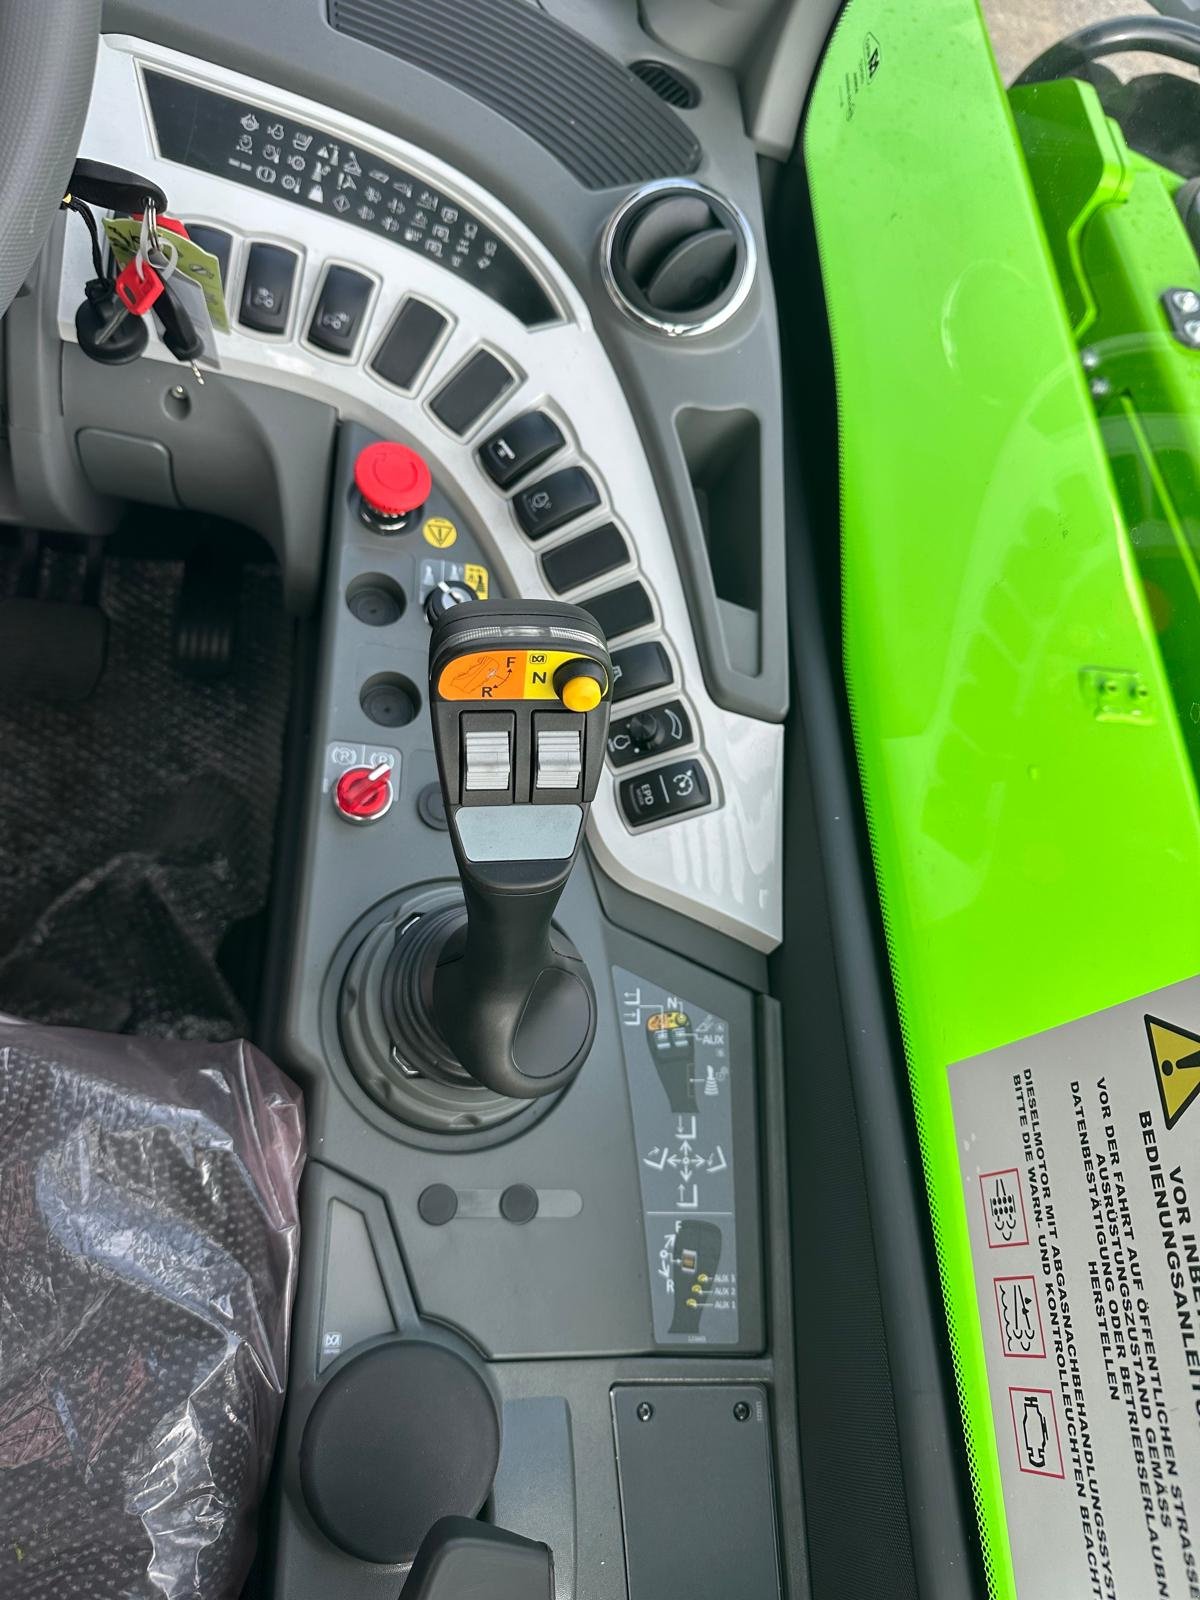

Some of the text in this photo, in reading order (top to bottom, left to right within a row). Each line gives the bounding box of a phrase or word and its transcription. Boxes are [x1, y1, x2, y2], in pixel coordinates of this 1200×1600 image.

[506, 656, 516, 668] F
[532, 671, 547, 684] N
[481, 686, 493, 698] R
[641, 783, 655, 806] EPD
[667, 996, 678, 1010] N
[702, 1034, 725, 1046] AUX
[1024, 1069, 1051, 1199] DIESELMOTOR
[1045, 1205, 1058, 1239] MIT
[675, 1220, 682, 1234] F
[1170, 1165, 1200, 1315] VOR INBE
[1097, 1077, 1112, 1120] VOR
[1105, 1125, 1120, 1166] DER
[1114, 1172, 1135, 1240] FAHRT
[1127, 1247, 1144, 1291] AUF
[1137, 1298, 1178, 1476] ÖFFENTLICHEN
[666, 1279, 675, 1294] R
[714, 1300, 729, 1310] AUX
[1013, 1074, 1103, 1600] BITTE DIE WARN- UND KONTROLLEUCHTEN BEACHT
[1070, 1081, 1171, 1600] DATENBESTÄTIGUNG ODER BETRIEBSERLAUBN
[1088, 1262, 1120, 1400] HERSTELLEN
[1096, 1154, 1172, 1528] AUSRÜSTUNGSZUSTAND GEMÄSS
